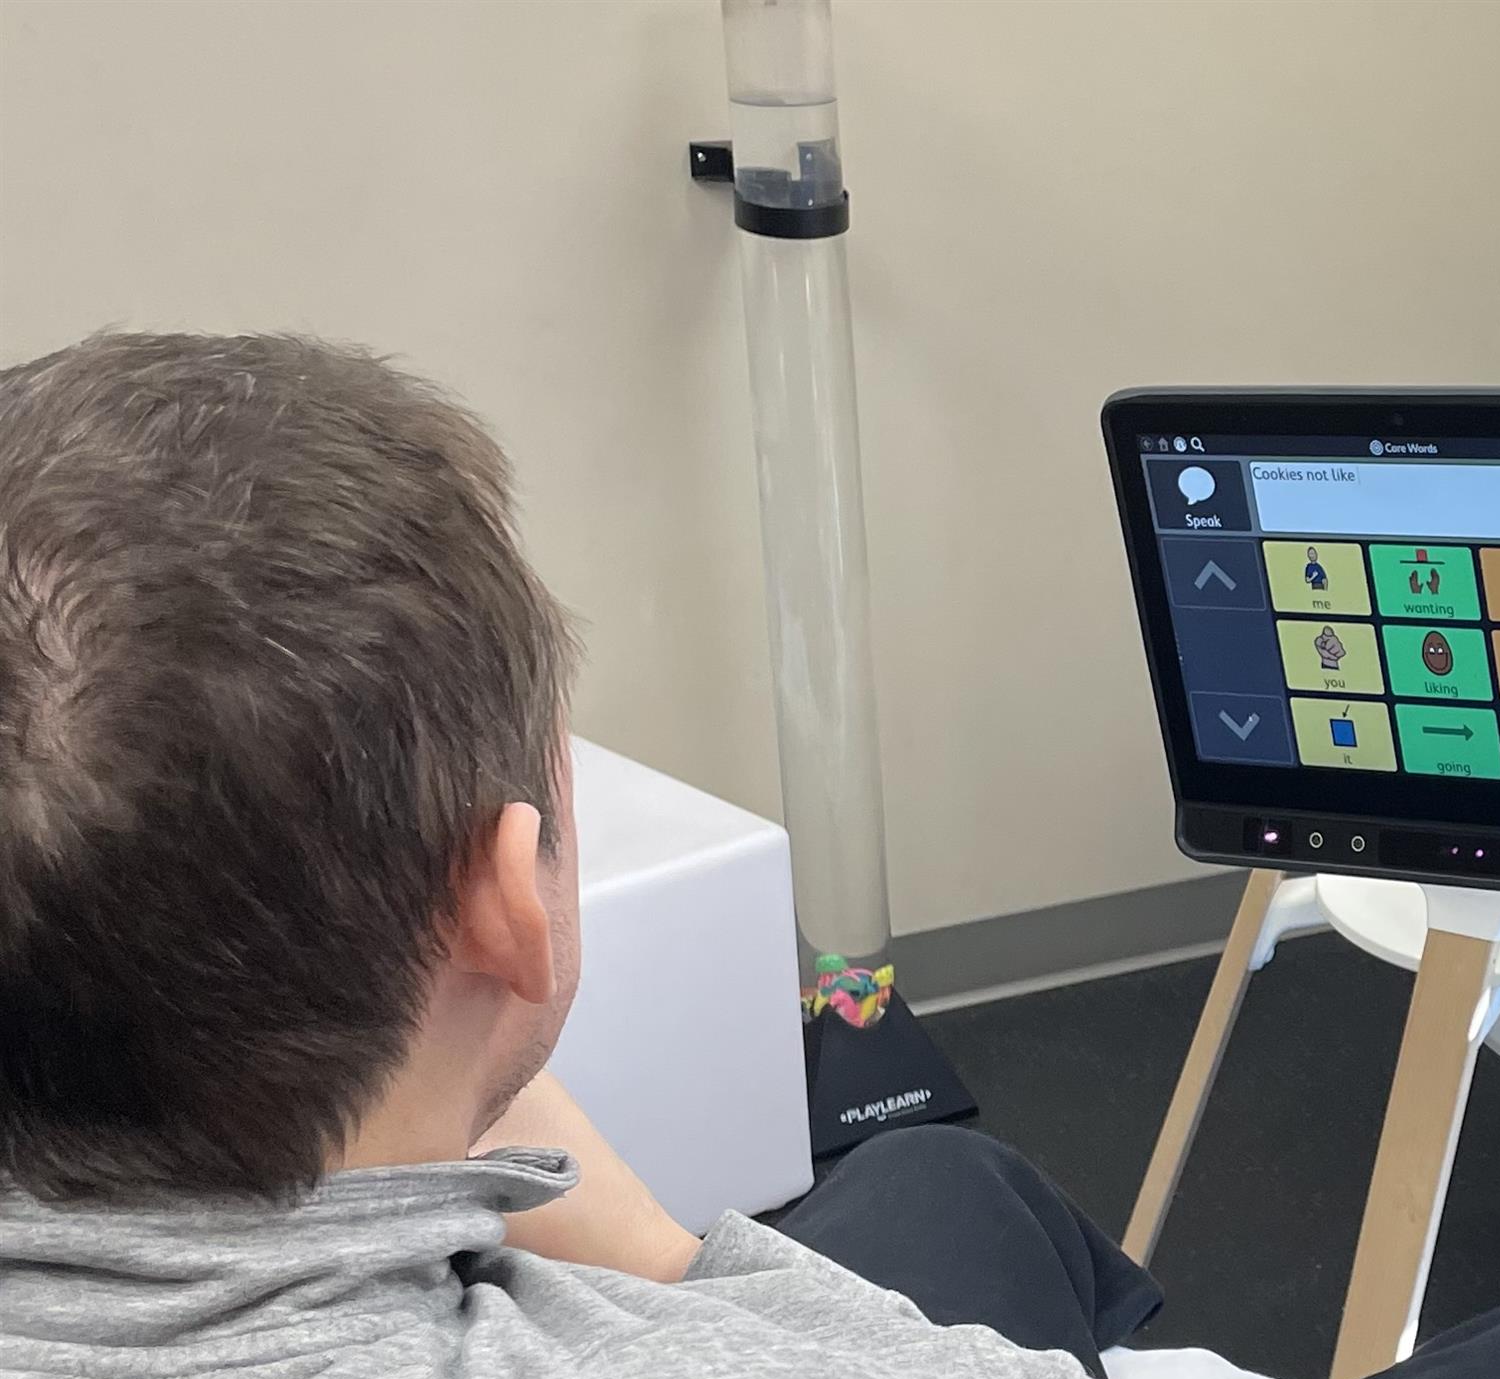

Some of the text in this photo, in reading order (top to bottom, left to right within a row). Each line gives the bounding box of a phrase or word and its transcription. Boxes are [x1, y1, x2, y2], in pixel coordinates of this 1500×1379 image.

[1384, 442, 1438, 454] Core Words
[1252, 466, 1356, 482] Cookies not like
[1185, 513, 1222, 529] Speak
[1312, 600, 1331, 610] me
[1403, 602, 1455, 617] wanting
[1323, 677, 1346, 690] you
[1424, 681, 1459, 697] liking
[1343, 754, 1353, 765] it
[1436, 761, 1472, 776] going
[845, 1089, 928, 1124] PLAYLEARN
